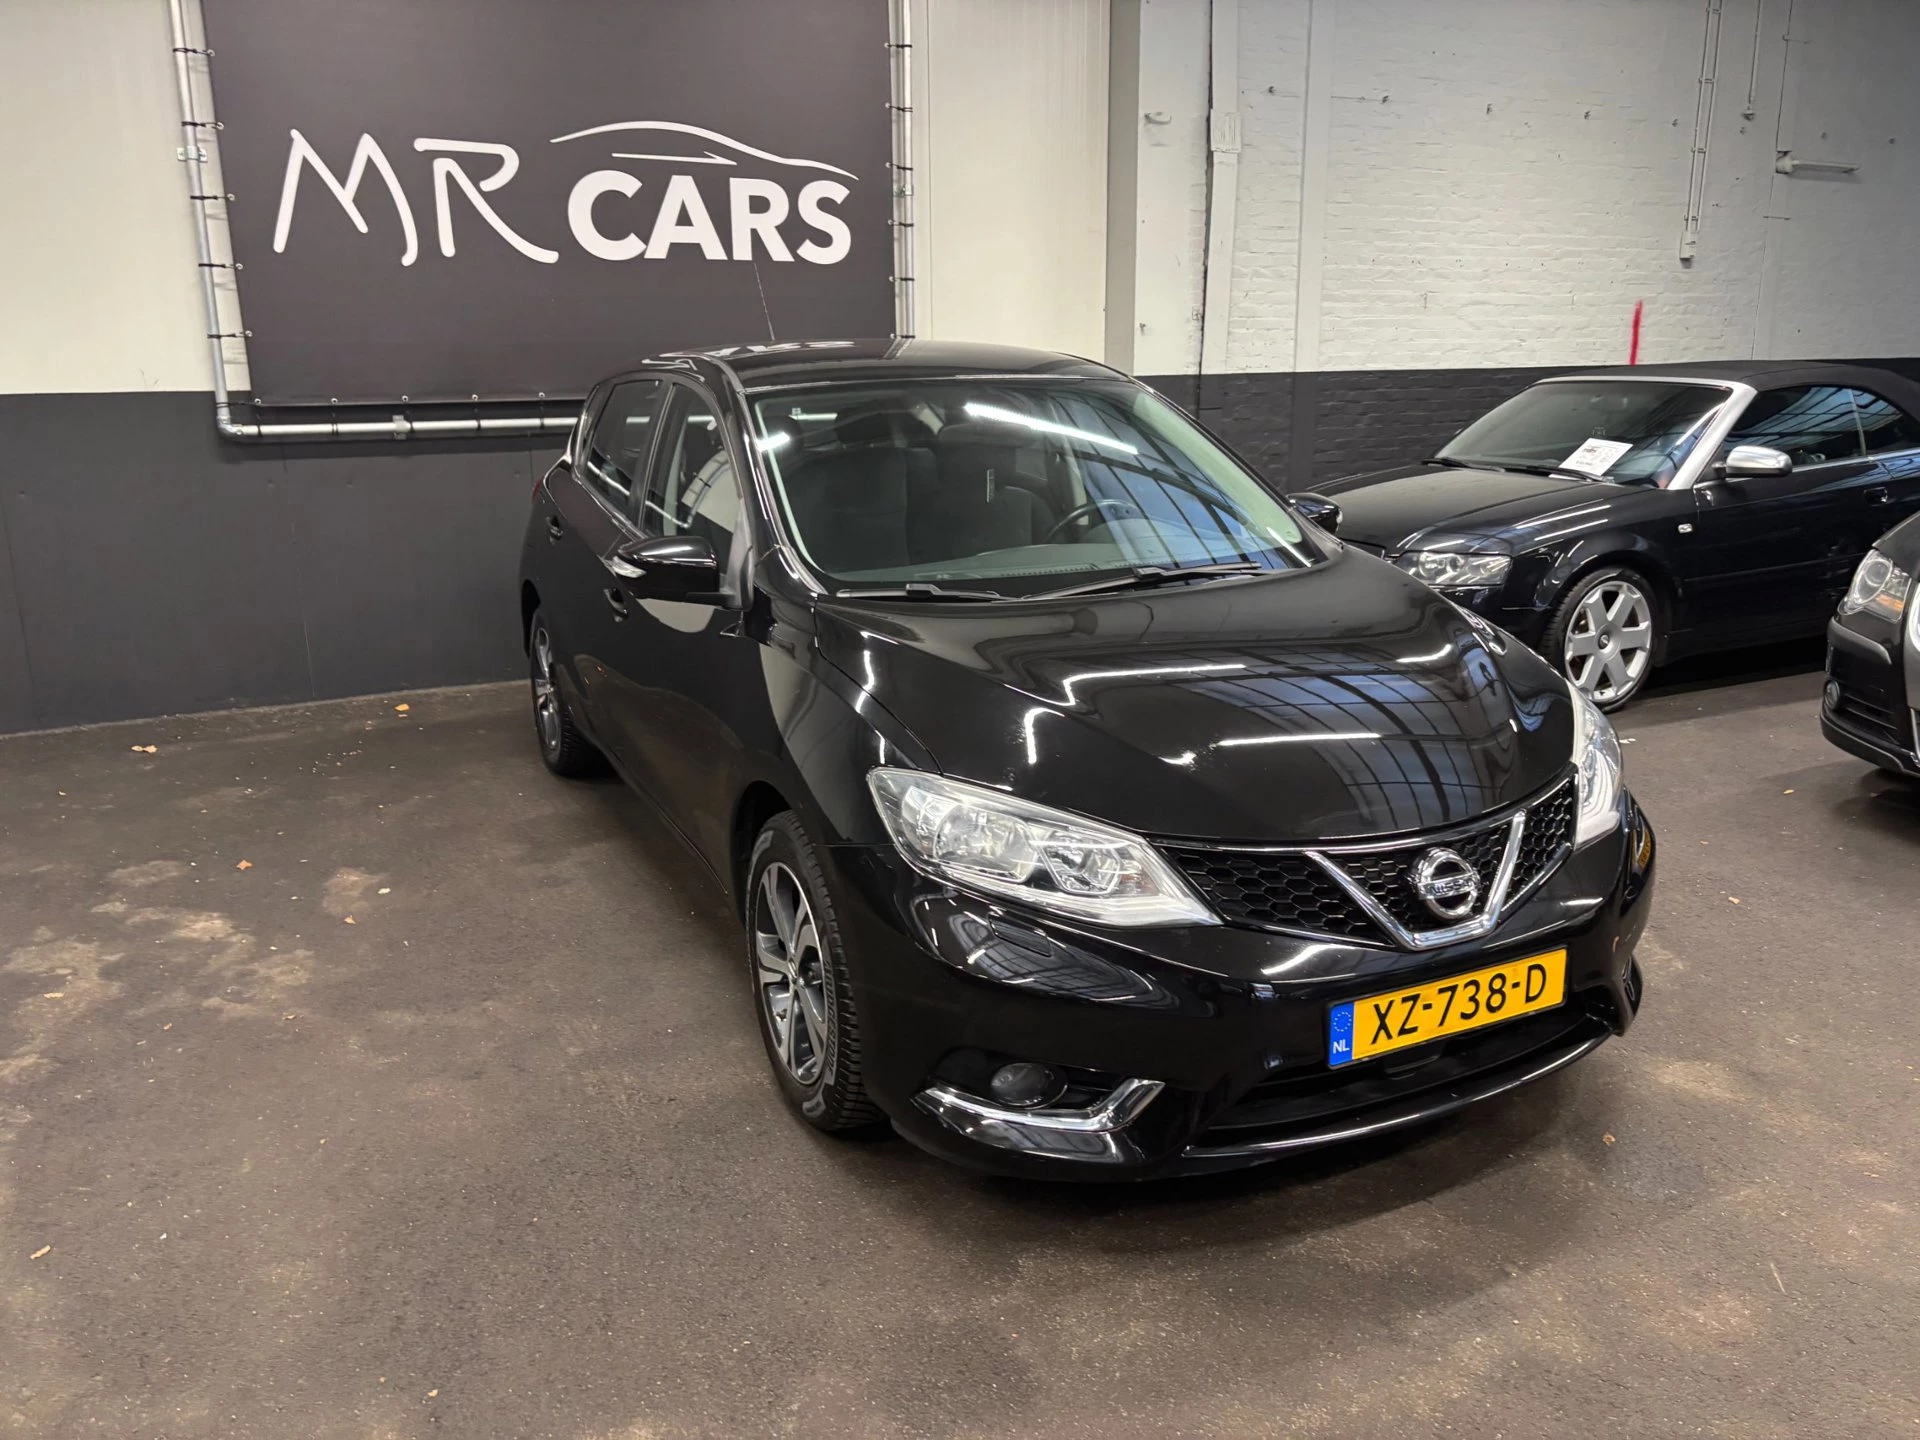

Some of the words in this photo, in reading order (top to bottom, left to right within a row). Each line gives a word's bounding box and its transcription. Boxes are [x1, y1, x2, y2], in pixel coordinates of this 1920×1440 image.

[273, 129, 559, 266] MR
[567, 169, 852, 265] CARS
[1371, 963, 1547, 1045] XZ-738-D
[1332, 1039, 1350, 1054] NL
